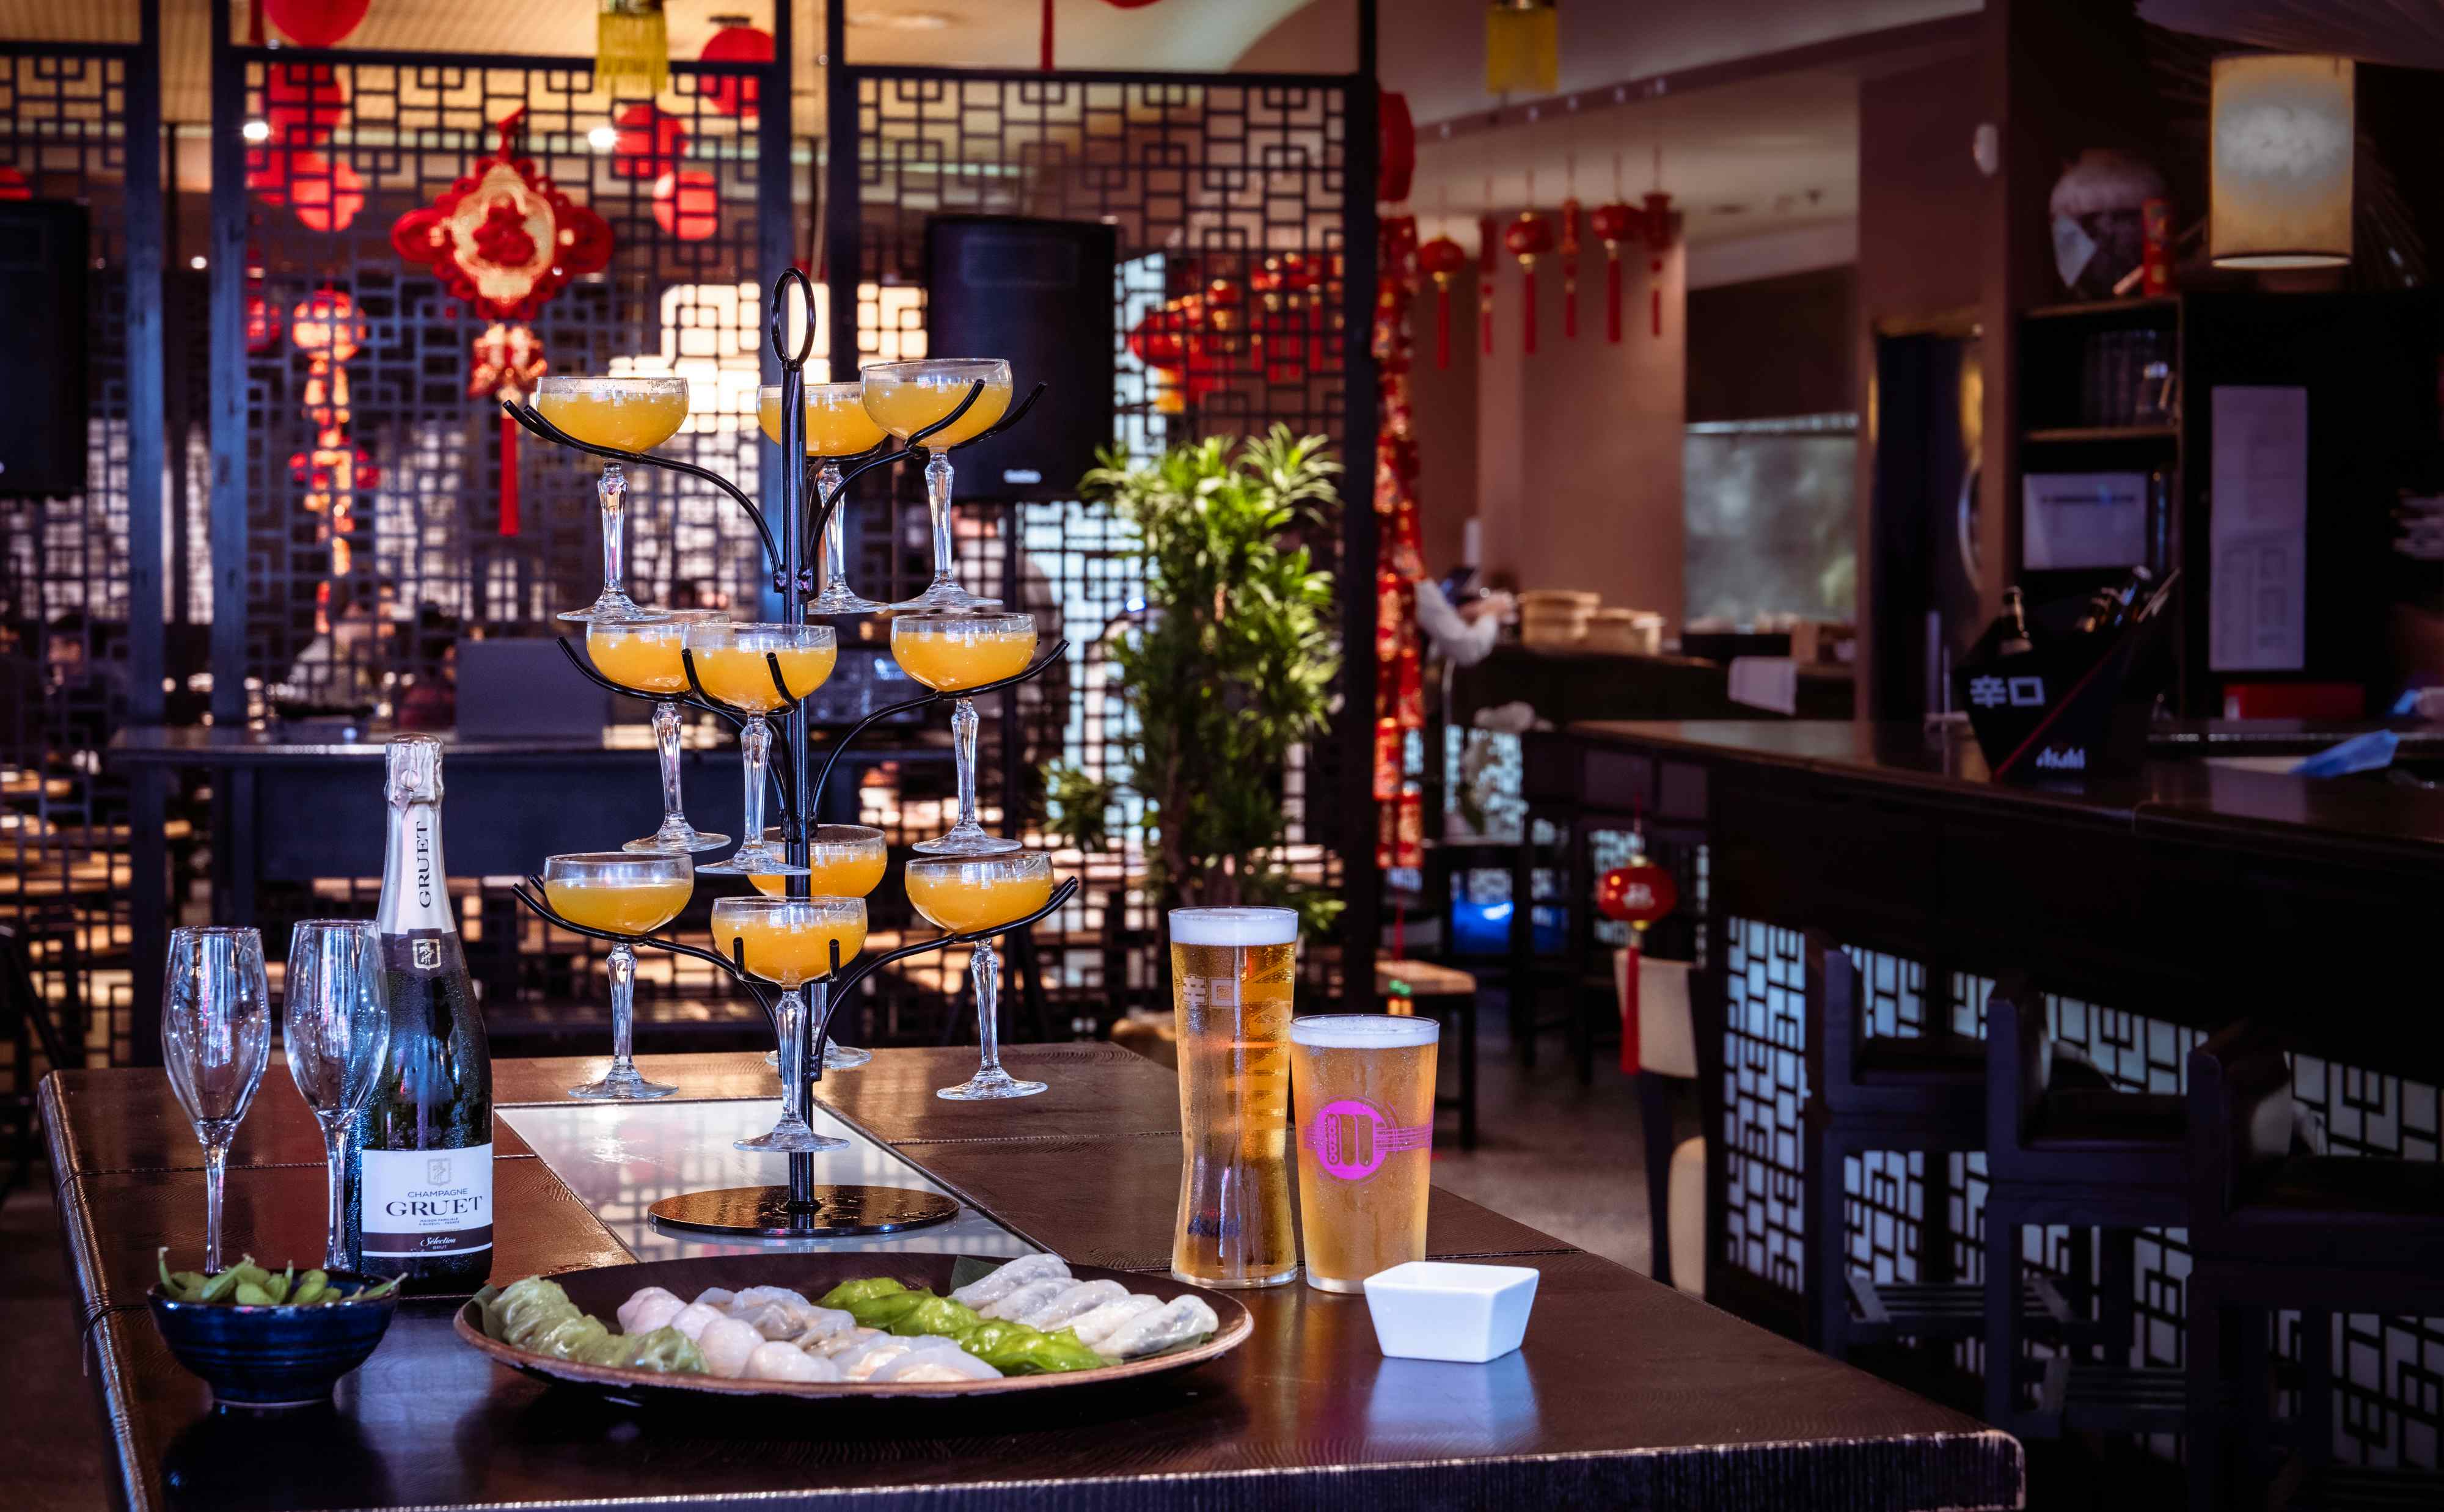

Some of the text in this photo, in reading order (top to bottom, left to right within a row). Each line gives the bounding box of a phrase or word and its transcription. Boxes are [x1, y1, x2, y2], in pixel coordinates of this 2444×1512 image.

[1969, 675, 2046, 709] 辛口
[417, 821, 431, 908] GRUET
[386, 1196, 483, 1216] GRUET
[408, 1188, 469, 1198] CHAMPAGNE
